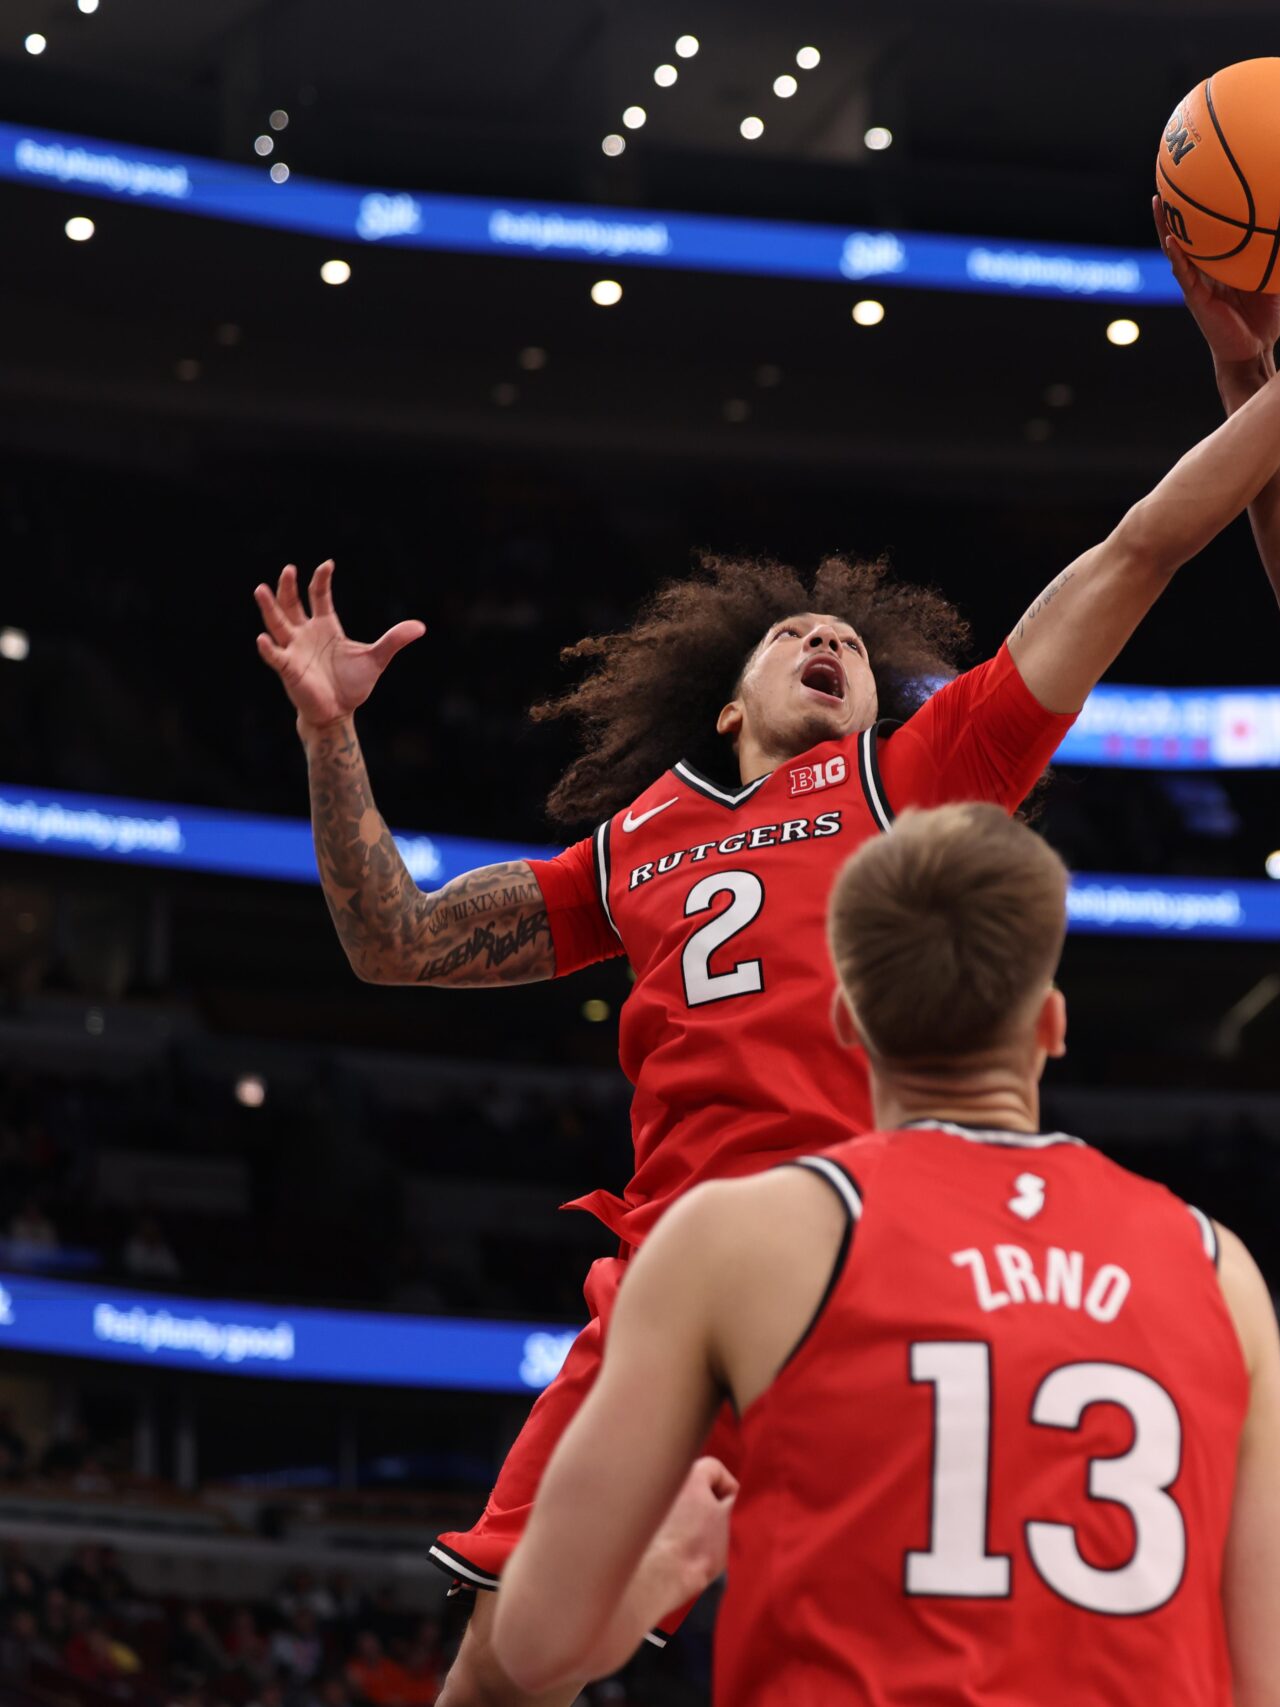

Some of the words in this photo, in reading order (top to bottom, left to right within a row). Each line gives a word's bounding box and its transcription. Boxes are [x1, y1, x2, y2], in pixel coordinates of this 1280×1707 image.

[628, 810, 843, 890] RUTGERS
[682, 868, 765, 1008] 2
[950, 1244, 1132, 1324] ZRNO
[904, 1340, 1188, 1617] 13
